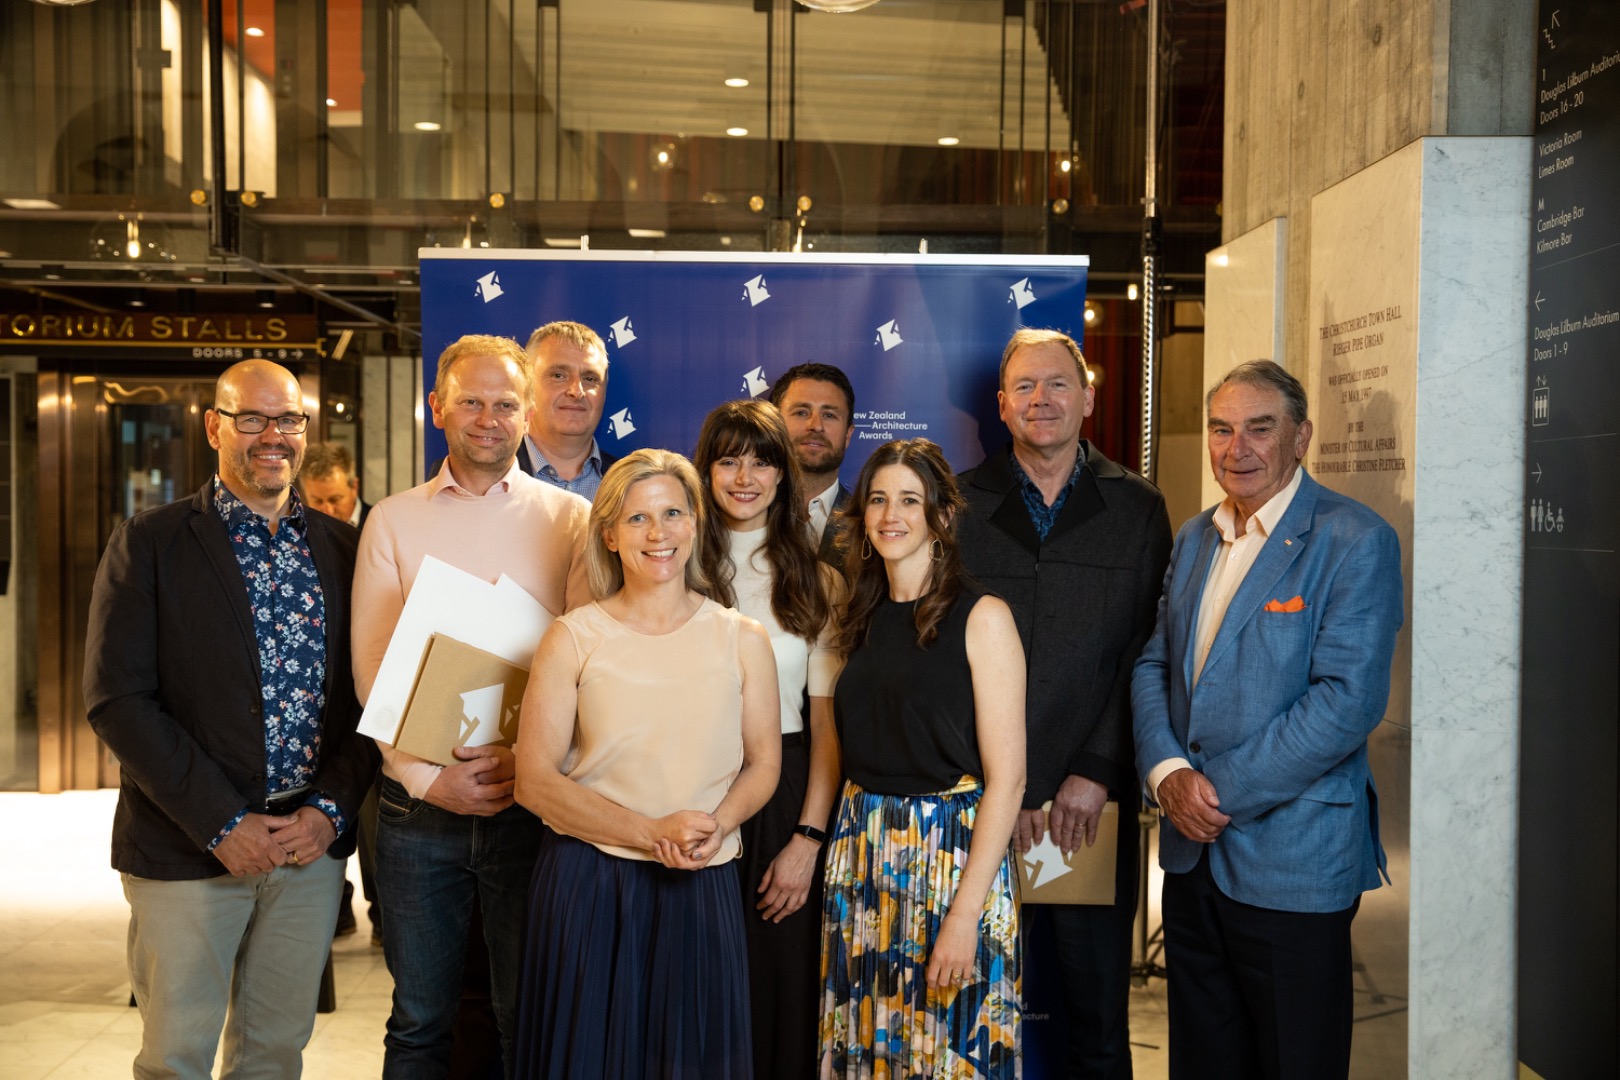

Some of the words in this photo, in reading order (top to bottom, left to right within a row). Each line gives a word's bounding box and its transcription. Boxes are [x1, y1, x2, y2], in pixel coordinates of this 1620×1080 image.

[1540, 81, 1566, 103] Douglas
[1567, 70, 1589, 89] Lilburn
[1540, 108, 1559, 125] Doors
[1560, 99, 1568, 114] 16
[1574, 90, 1584, 108] 20
[1539, 137, 1563, 157] Victoria
[1563, 130, 1582, 146] Room
[1538, 164, 1555, 179] Limes
[1556, 156, 1575, 171] Room
[1538, 197, 1545, 212] M
[1537, 210, 1572, 233] Cambridge
[1573, 206, 1585, 220] Bar
[1536, 237, 1560, 254] Kilmore
[1561, 232, 1573, 246] Bar
[151, 316, 287, 340] STALLS
[1319, 326, 1329, 340] THE
[1368, 309, 1386, 327] TOWN
[1386, 305, 1402, 322] HALL
[1534, 322, 1559, 341] Douglas
[1560, 318, 1581, 334] Lilburn
[1582, 310, 1620, 329] Auditorium
[1352, 337, 1363, 352] PIPE
[1364, 331, 1384, 349] ORGAN
[1534, 348, 1552, 361] Doors
[1553, 344, 1557, 357] 1
[1563, 341, 1568, 355] 9
[192, 347, 244, 359] DOORS
[1362, 366, 1380, 380] OPENED
[1380, 364, 1389, 377] ON
[853, 412, 867, 420] ew
[868, 411, 906, 420] Zealand
[871, 421, 928, 431] Architecture
[858, 431, 893, 440] Awards
[1348, 439, 1374, 453] CULTURAL
[1374, 437, 1396, 451] AFFAIRS
[1352, 459, 1378, 473] CHRISTINE
[1378, 457, 1406, 472] FLETCHER
